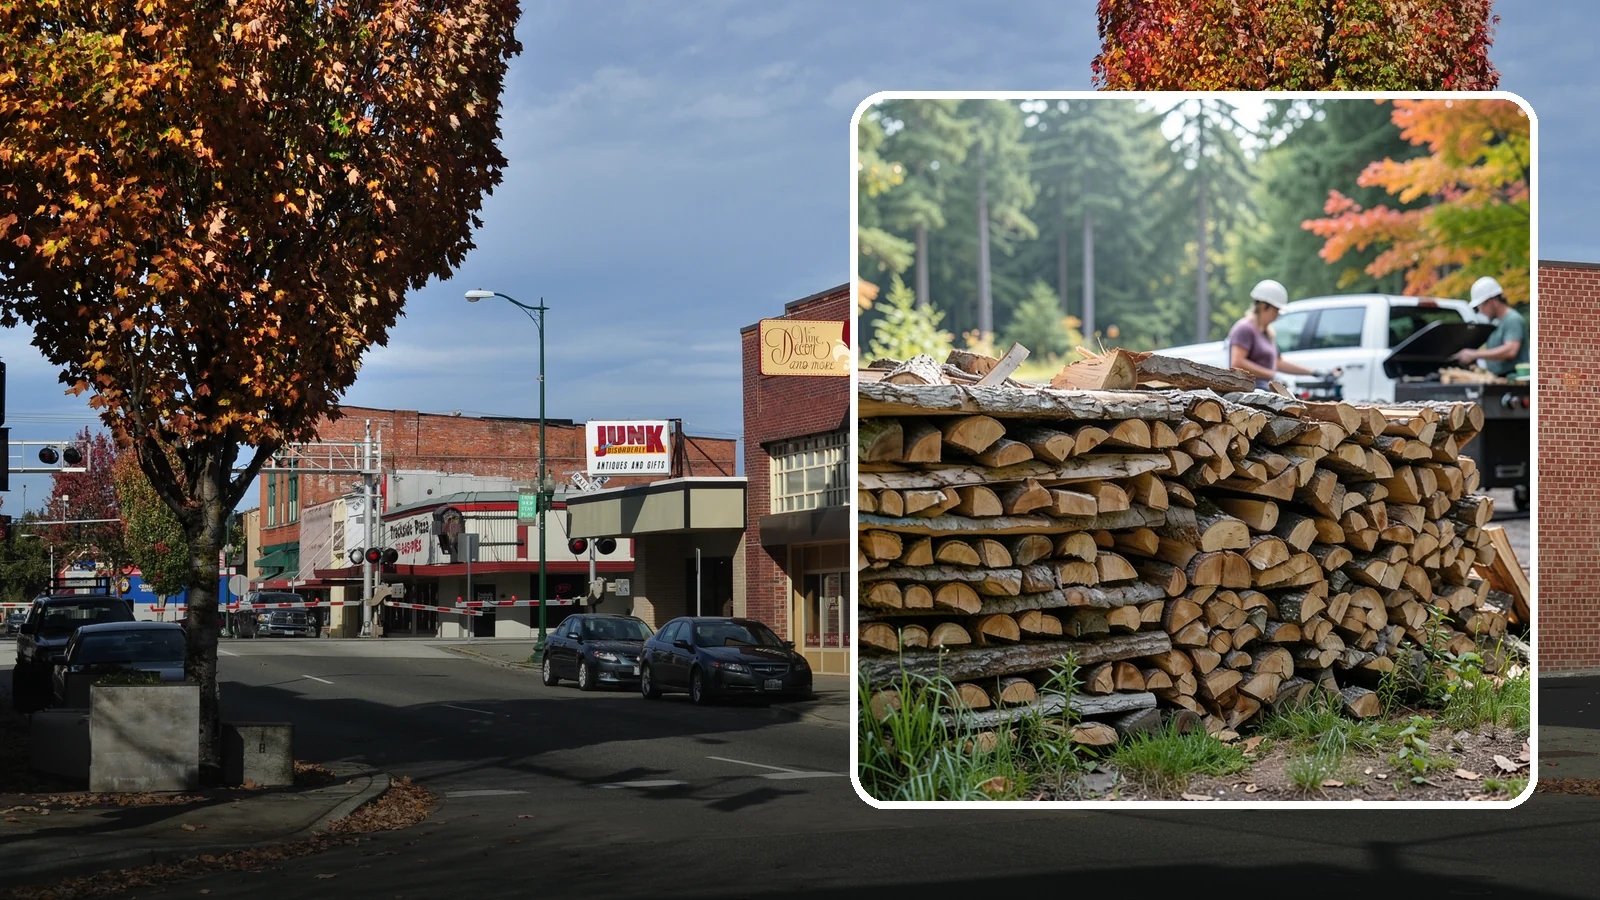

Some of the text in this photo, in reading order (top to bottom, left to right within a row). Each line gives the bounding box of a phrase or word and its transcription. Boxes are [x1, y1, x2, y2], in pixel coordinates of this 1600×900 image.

[791, 325, 823, 345] Wine
[596, 425, 665, 457] JUNK
[597, 460, 665, 470] ANTIQUES AND GIFTS
[390, 520, 429, 540] Trackside Pizza
